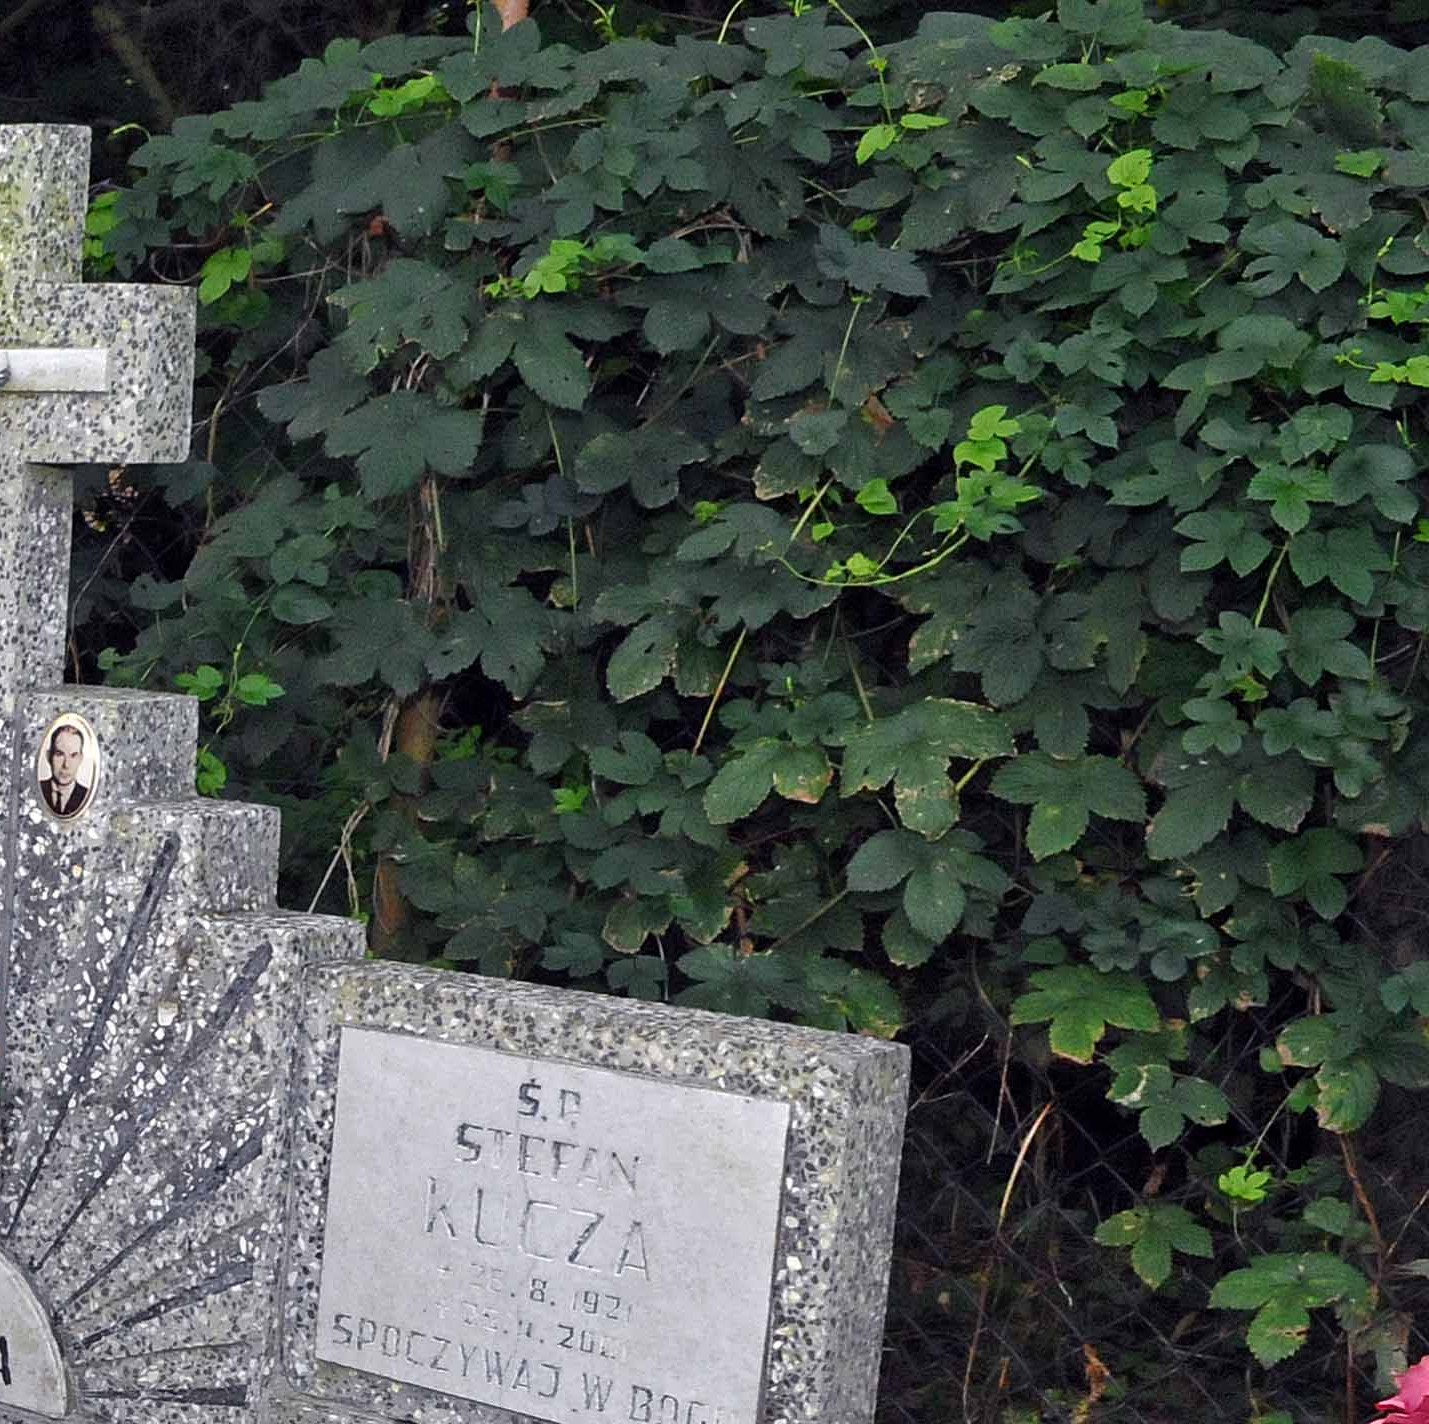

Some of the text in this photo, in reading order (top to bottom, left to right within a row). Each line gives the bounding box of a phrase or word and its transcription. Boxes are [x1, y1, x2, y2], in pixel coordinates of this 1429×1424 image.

[454, 1121, 641, 1194] STEFAN
[425, 1175, 652, 1282] KUCZA
[332, 1313, 561, 1400] SPOCZYWAJ
[583, 1371, 614, 1413] W
